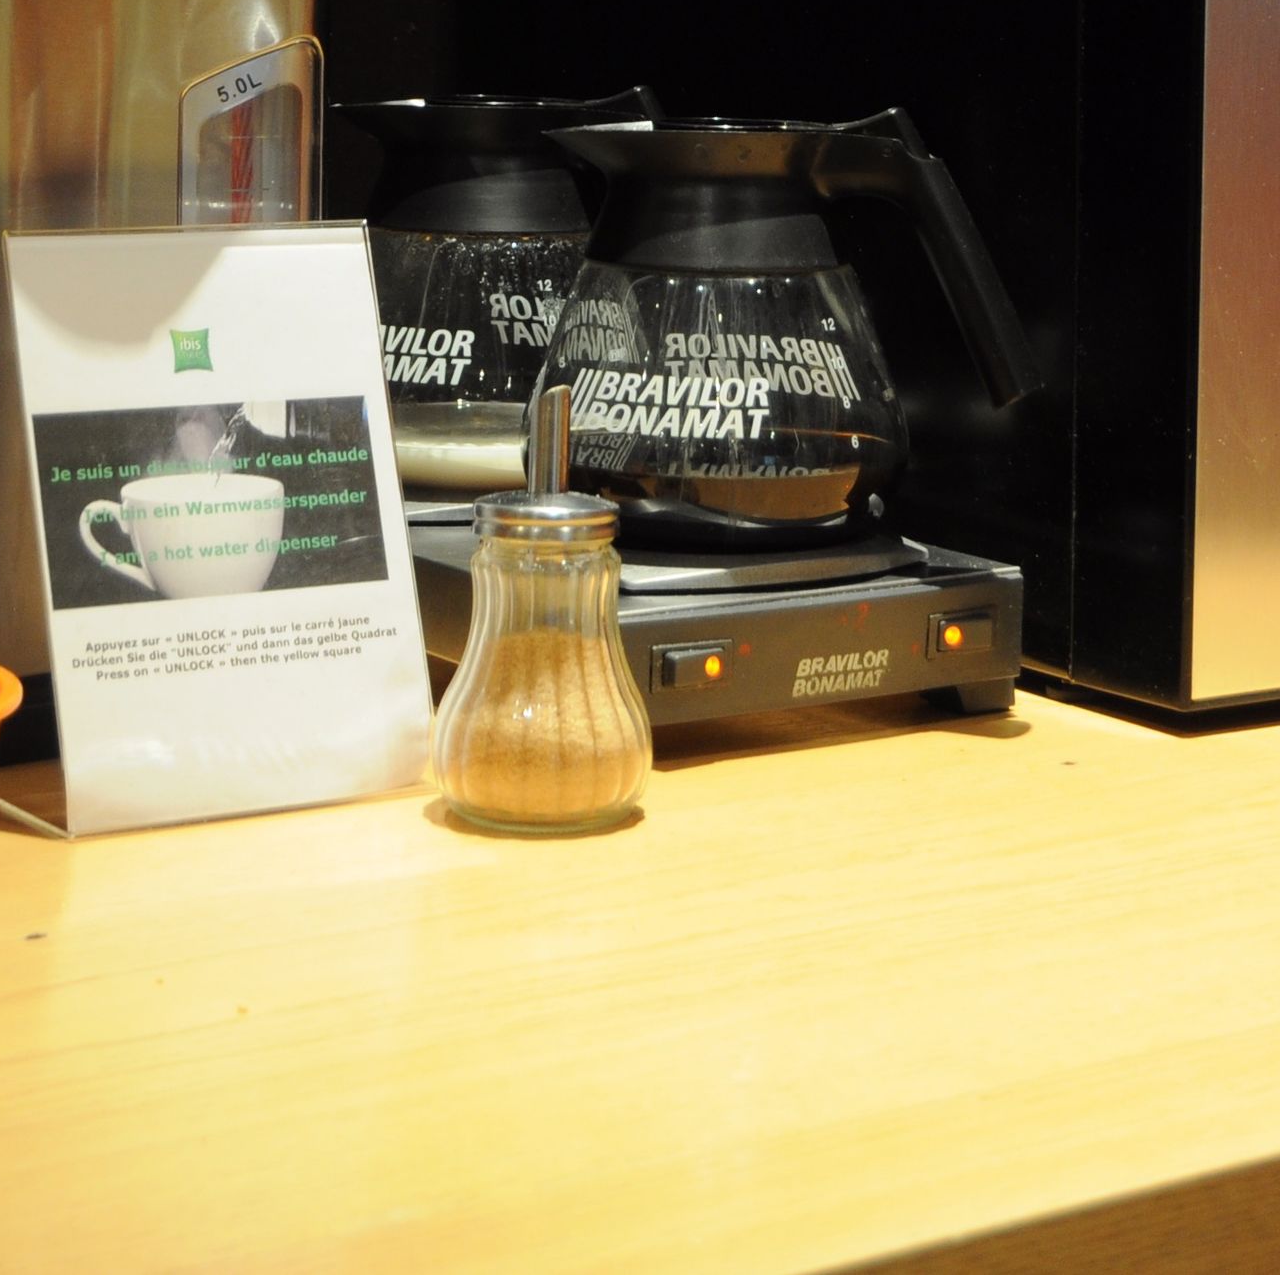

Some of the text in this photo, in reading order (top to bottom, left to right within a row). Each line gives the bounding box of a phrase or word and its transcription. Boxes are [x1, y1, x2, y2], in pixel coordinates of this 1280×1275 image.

[217, 73, 262, 103] 5.0L
[536, 279, 552, 291] 12
[821, 317, 836, 332] 12
[180, 337, 201, 351] ibis
[596, 370, 770, 407] BRAVILOR
[842, 395, 851, 409] 8
[584, 401, 770, 439] BONAMAT
[851, 434, 860, 449] 6
[51, 466, 71, 482] Je
[76, 463, 113, 481] suis
[118, 464, 140, 478] un
[255, 451, 302, 468] d'eau
[308, 447, 368, 465] chaude
[120, 506, 147, 520] bin
[153, 503, 179, 517] ein
[185, 489, 368, 516] Warmwasserspender
[115, 551, 140, 566] am
[148, 551, 158, 563] a
[164, 546, 192, 562] hot
[199, 541, 249, 558] water
[255, 533, 338, 555] dispenser
[72, 655, 123, 669] Drücken
[127, 651, 145, 663] Sie
[149, 649, 167, 661] die
[236, 640, 258, 652] und
[262, 638, 290, 650] dann
[294, 635, 313, 647] das
[317, 632, 348, 646] gelbe
[351, 627, 397, 643] Quadrat
[85, 615, 370, 653] Appuyez sur UNLOCK puis sur le carré jaune
[96, 644, 361, 681] Press on UNLOCK then the yellow square
[796, 649, 889, 677] BRAVILOR
[792, 669, 884, 698] BONAMAT
